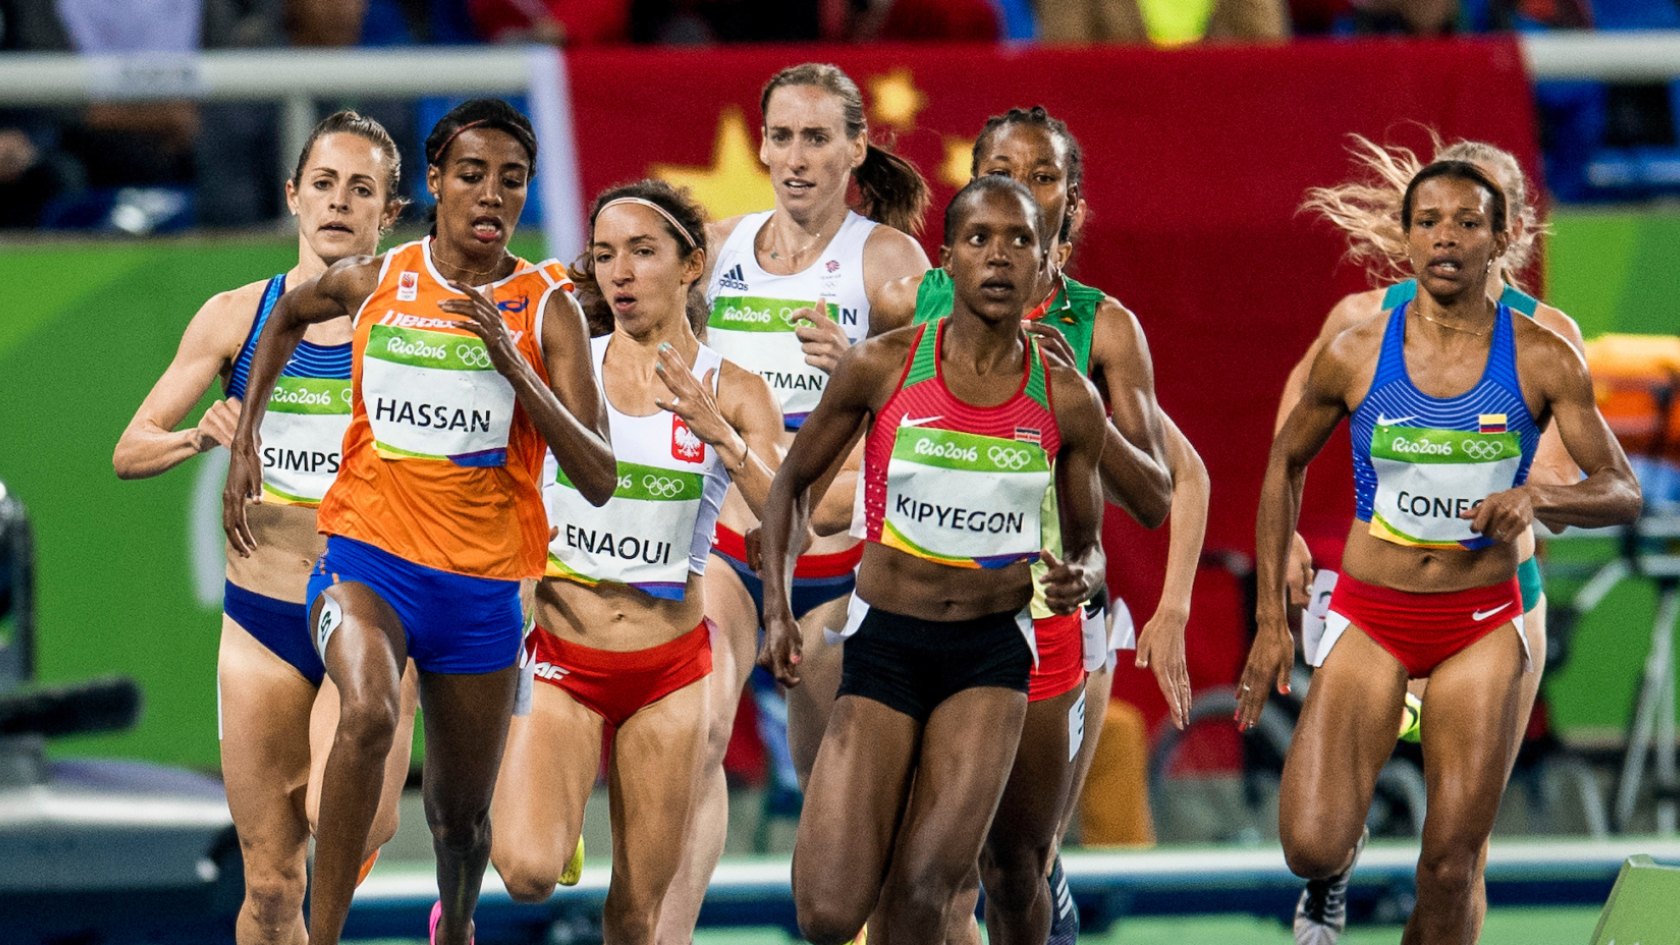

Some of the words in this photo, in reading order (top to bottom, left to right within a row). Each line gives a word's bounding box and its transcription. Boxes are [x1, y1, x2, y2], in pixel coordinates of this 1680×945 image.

[718, 278, 749, 292] adidas
[722, 306, 771, 323] Rio2016
[387, 336, 447, 360] Rio2016
[751, 370, 823, 391] TMAN
[271, 386, 331, 405] Rio2016
[375, 397, 491, 433] HASSAN
[914, 438, 978, 462] Rio2016
[1392, 437, 1453, 456] Rio2016
[263, 447, 340, 474] SIMPS
[896, 493, 1025, 534] KIPYEGON
[566, 523, 671, 565] ENAOUI
